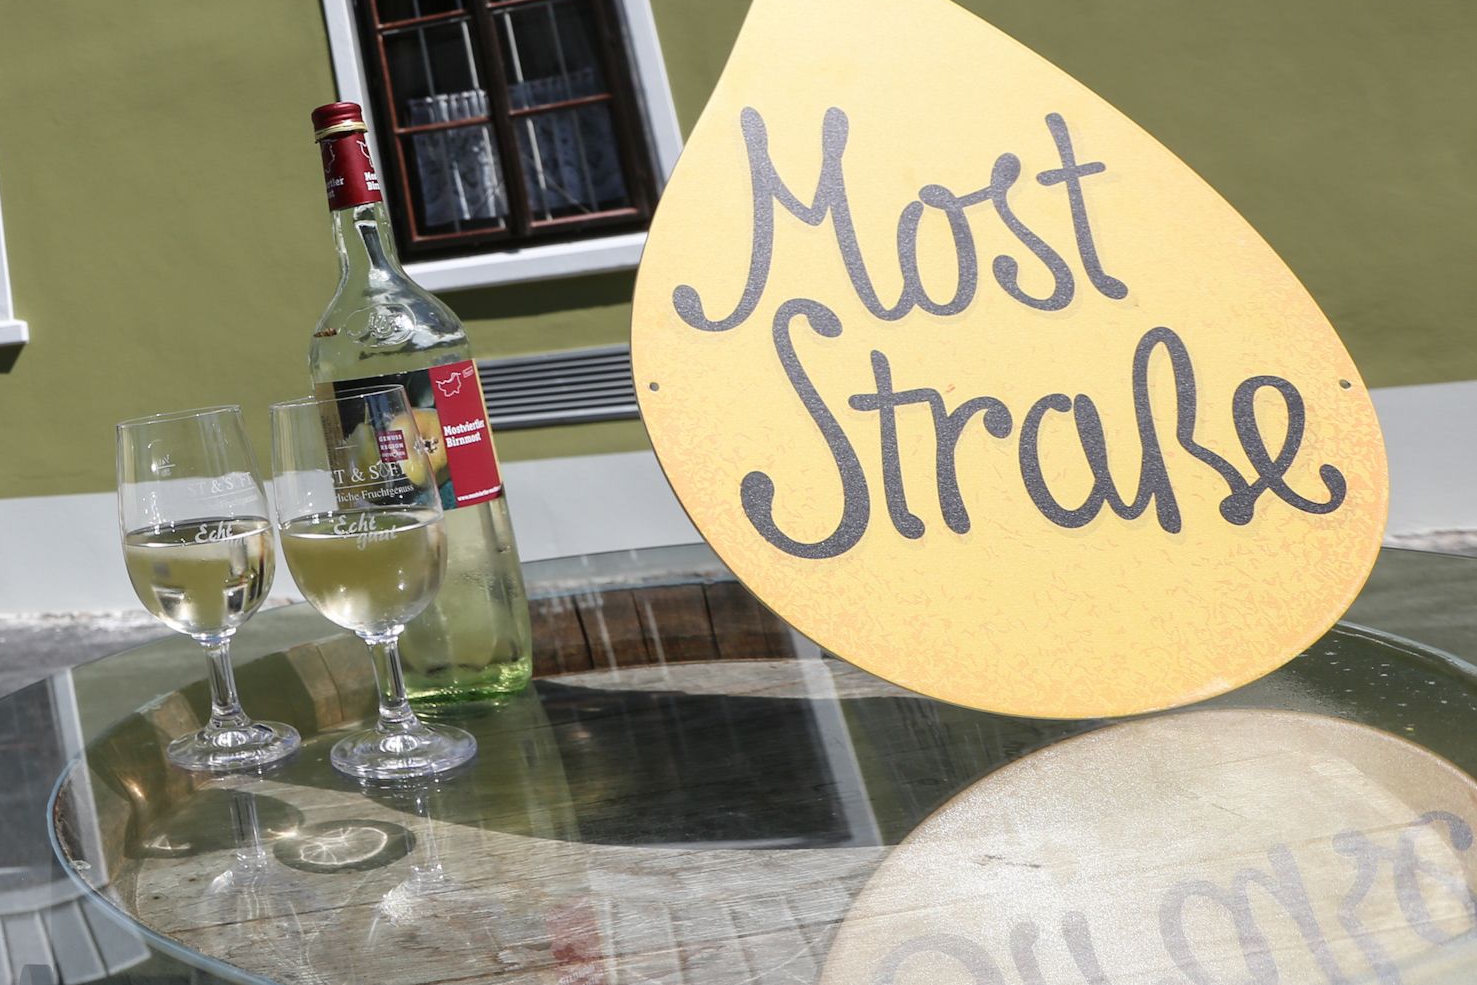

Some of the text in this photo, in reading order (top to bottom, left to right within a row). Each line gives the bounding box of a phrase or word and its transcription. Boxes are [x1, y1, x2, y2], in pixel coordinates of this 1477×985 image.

[671, 106, 1128, 332] Most
[443, 418, 485, 437] Mostviertler
[740, 297, 1346, 559] Straße
[445, 431, 482, 448] Birnmost
[195, 521, 233, 543] Echt
[333, 512, 378, 535] Echt
